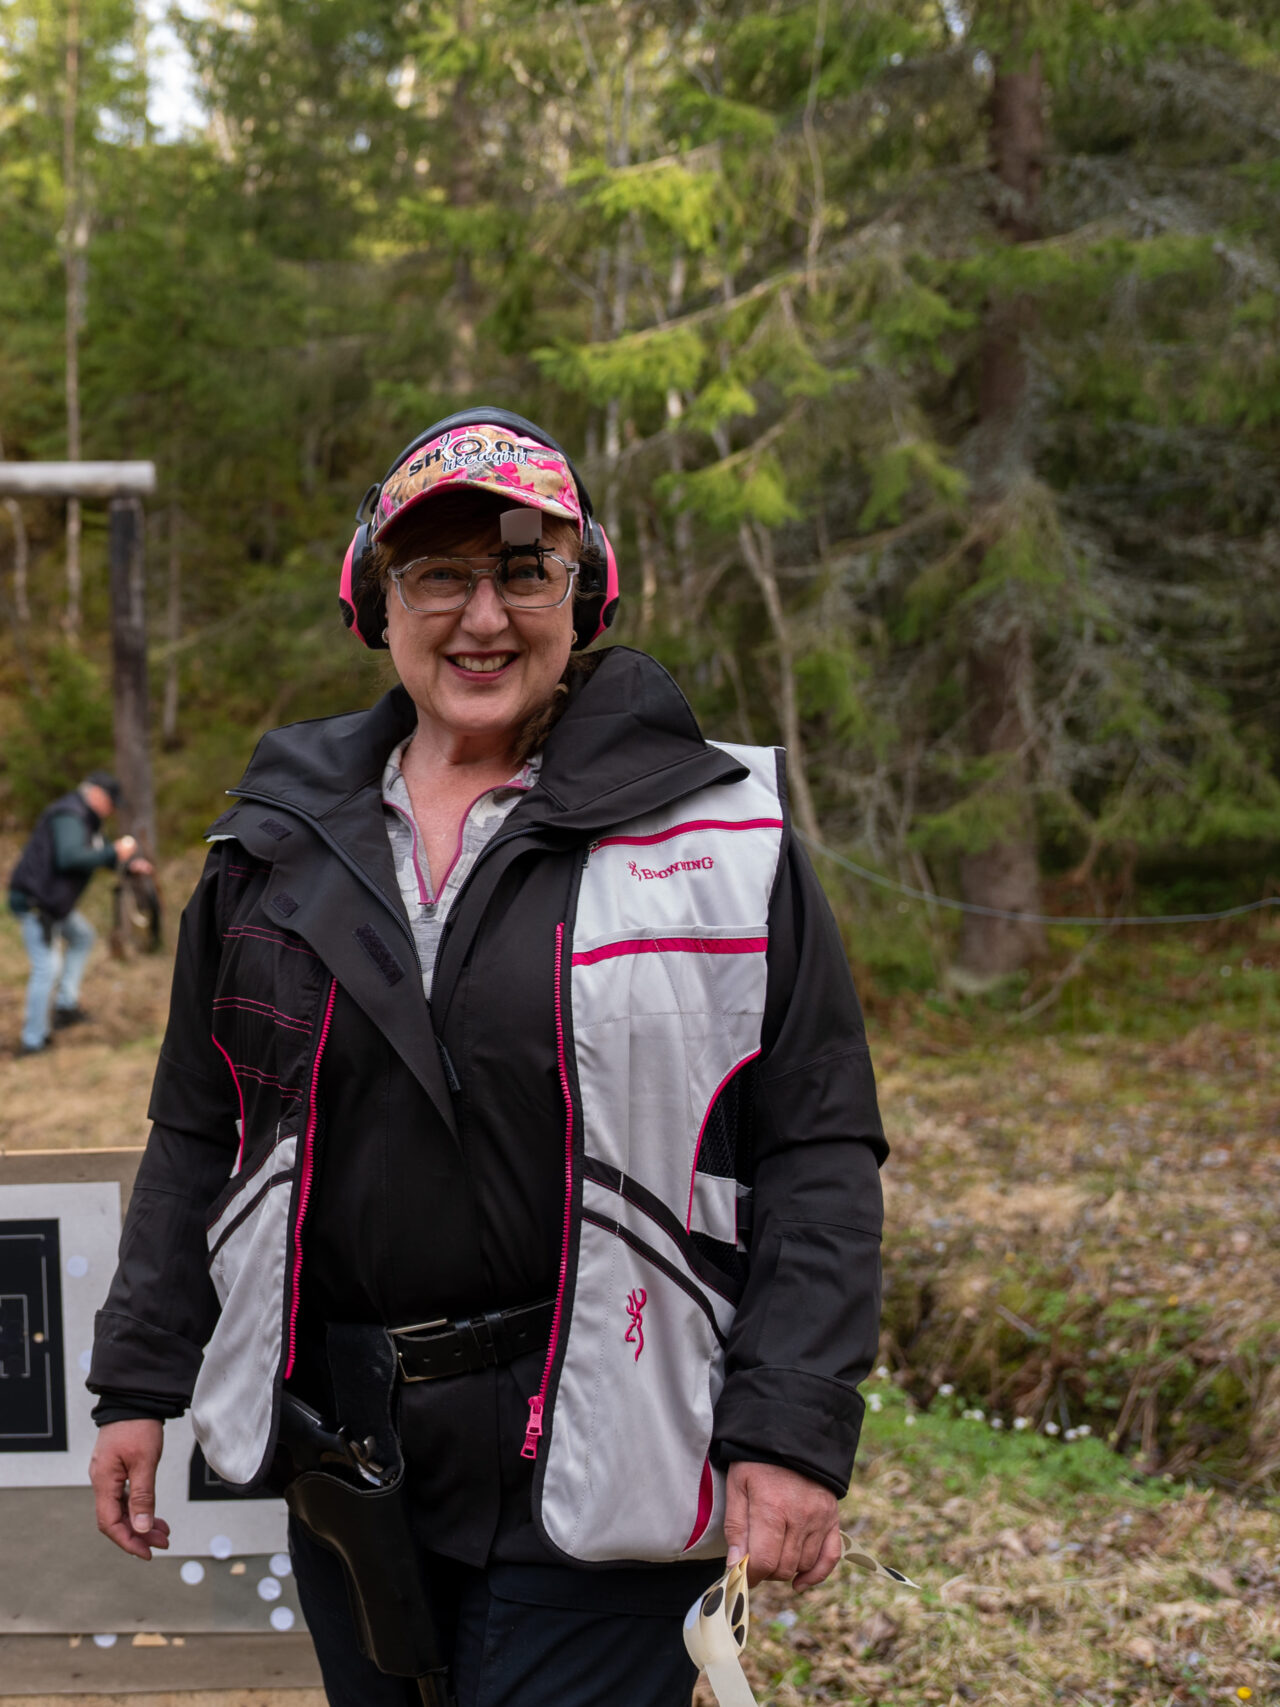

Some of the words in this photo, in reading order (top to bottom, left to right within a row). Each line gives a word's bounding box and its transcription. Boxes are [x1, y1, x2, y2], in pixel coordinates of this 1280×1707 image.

[408, 437, 535, 477] SHOOT
[442, 454, 475, 473] like
[477, 451, 491, 463] a
[491, 450, 529, 466] girl!
